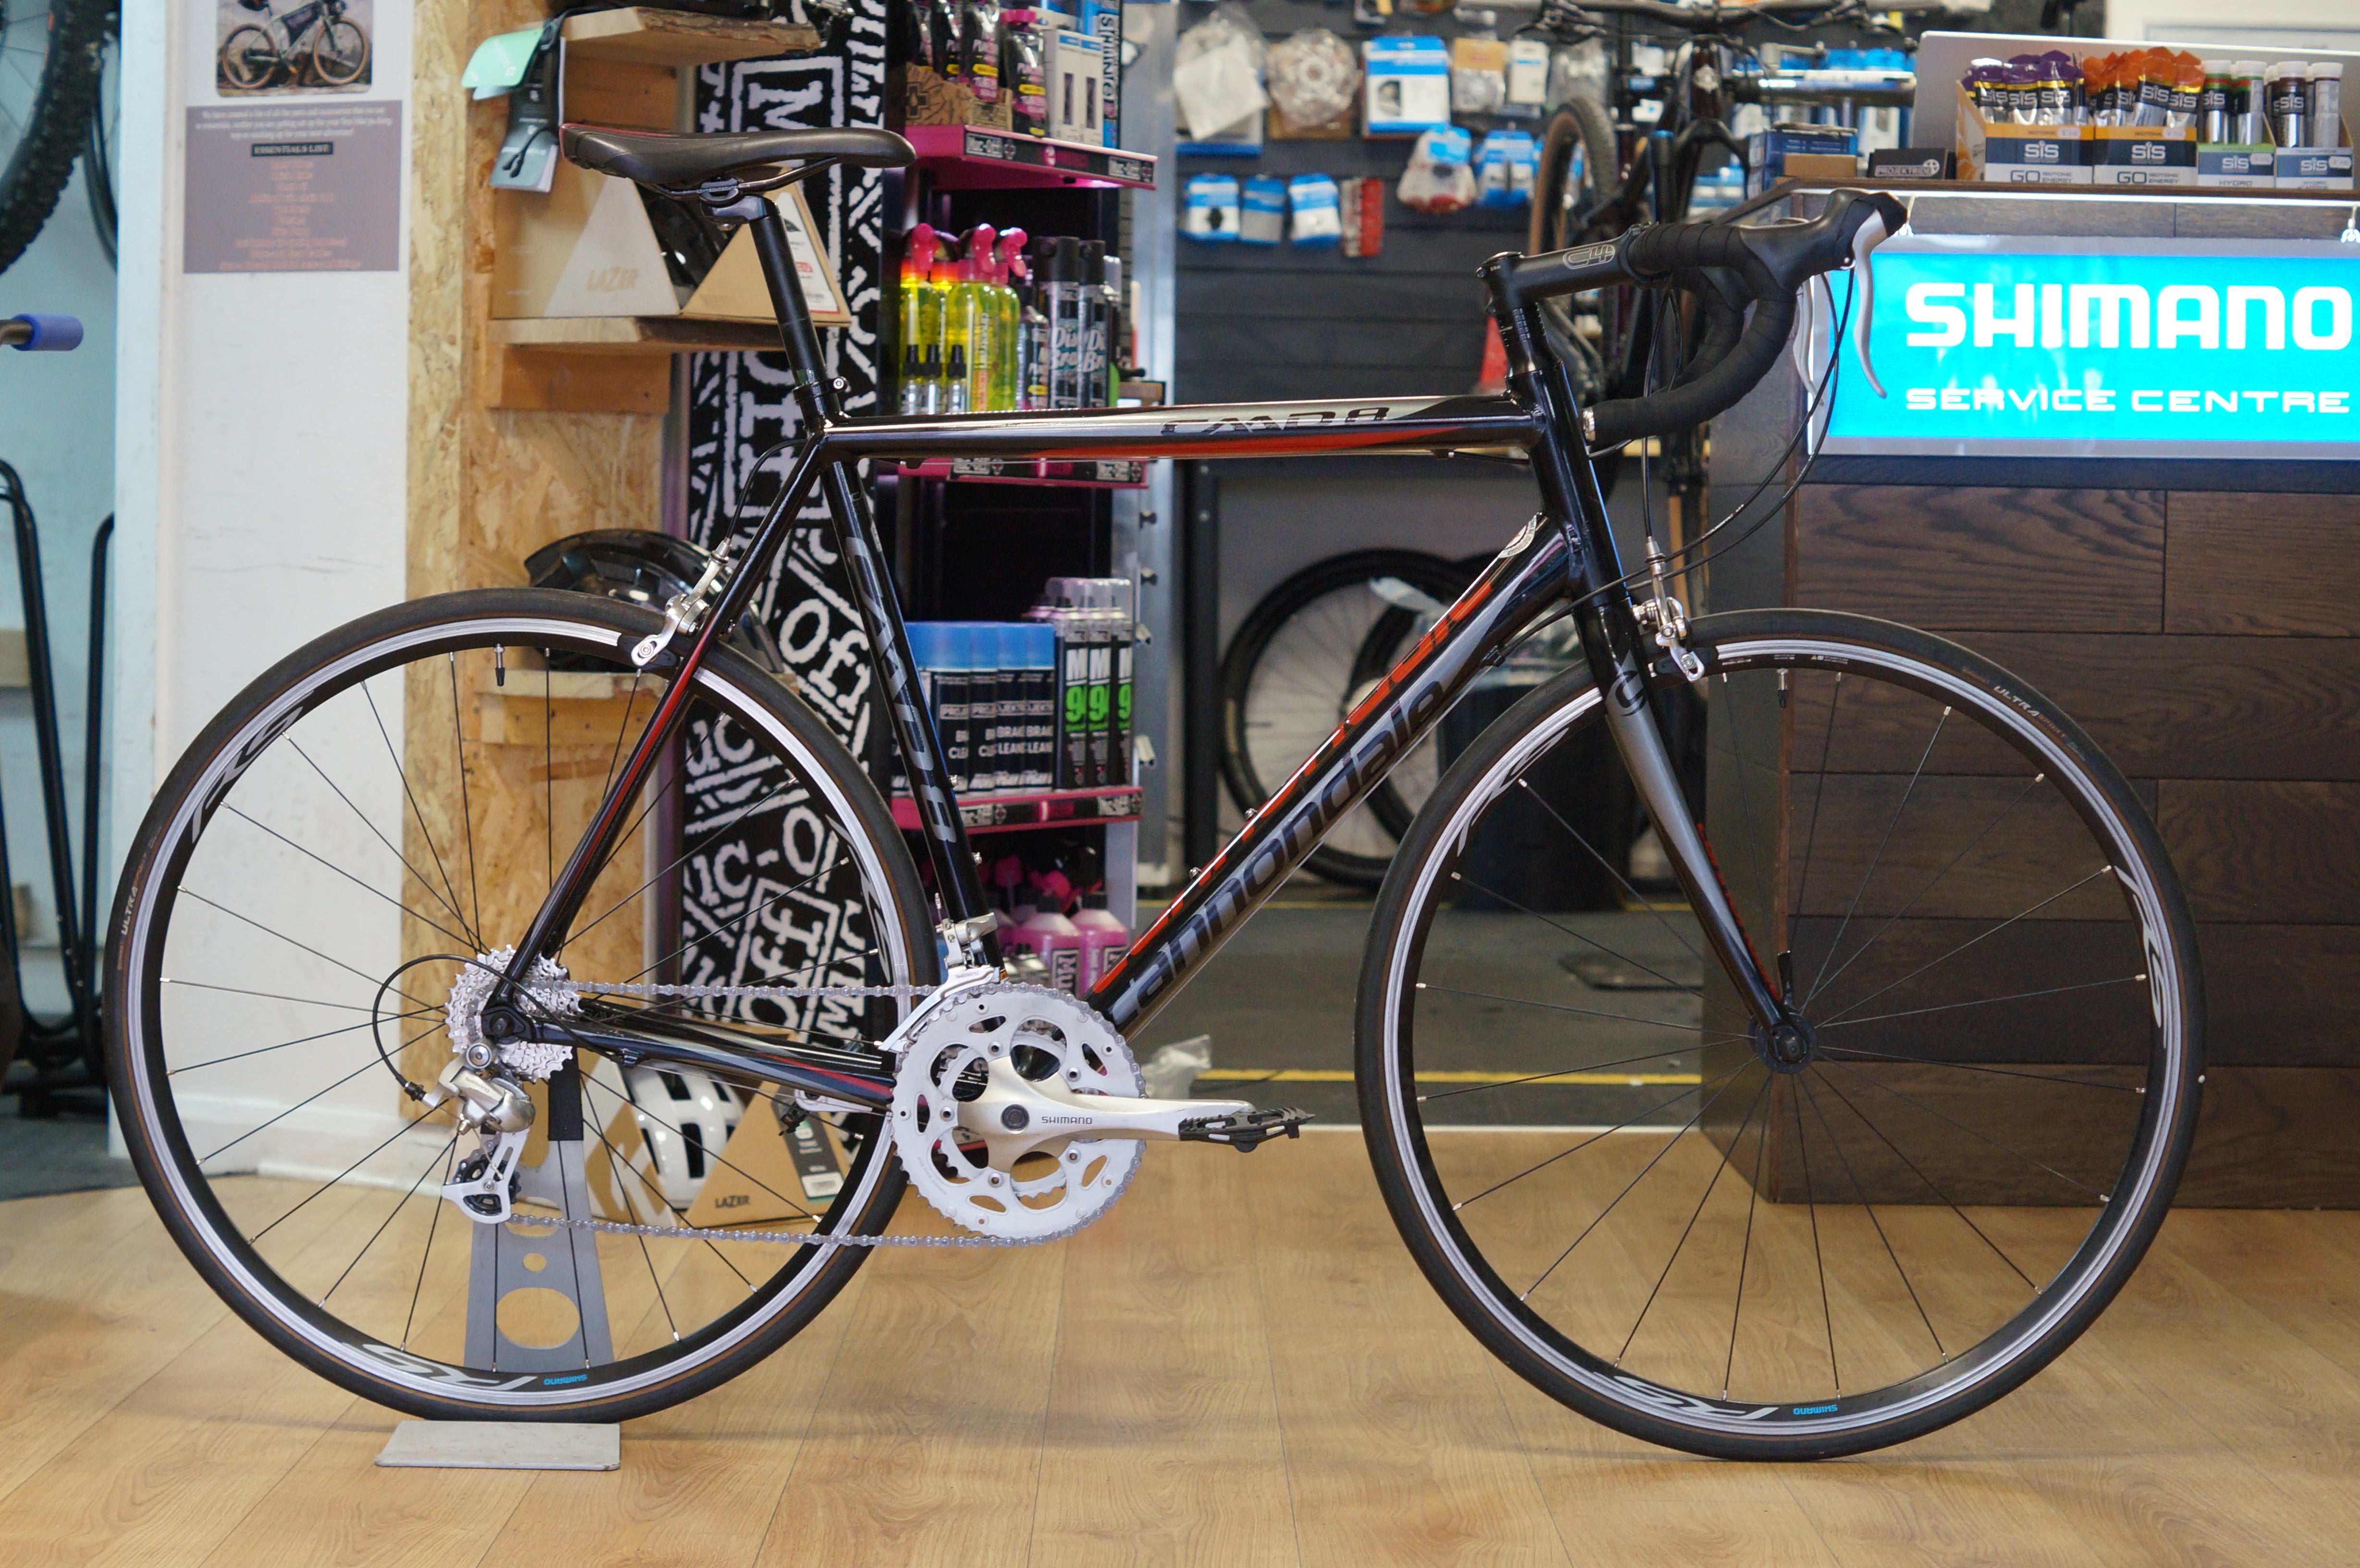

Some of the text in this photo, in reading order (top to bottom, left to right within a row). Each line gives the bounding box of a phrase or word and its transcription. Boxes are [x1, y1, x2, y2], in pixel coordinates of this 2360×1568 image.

[1905, 282, 2353, 351] SHIMANO
[1905, 389, 2350, 414] SERVICE CENTRE
[1993, 685, 2040, 717] ULTRA
[121, 886, 138, 936] ULTRA
[1041, 1115, 1093, 1125] SHIMANO
[714, 1195, 750, 1209] LAZER
[543, 1373, 588, 1385] SHIMANO
[1793, 1404, 1838, 1415] SHIMANO
